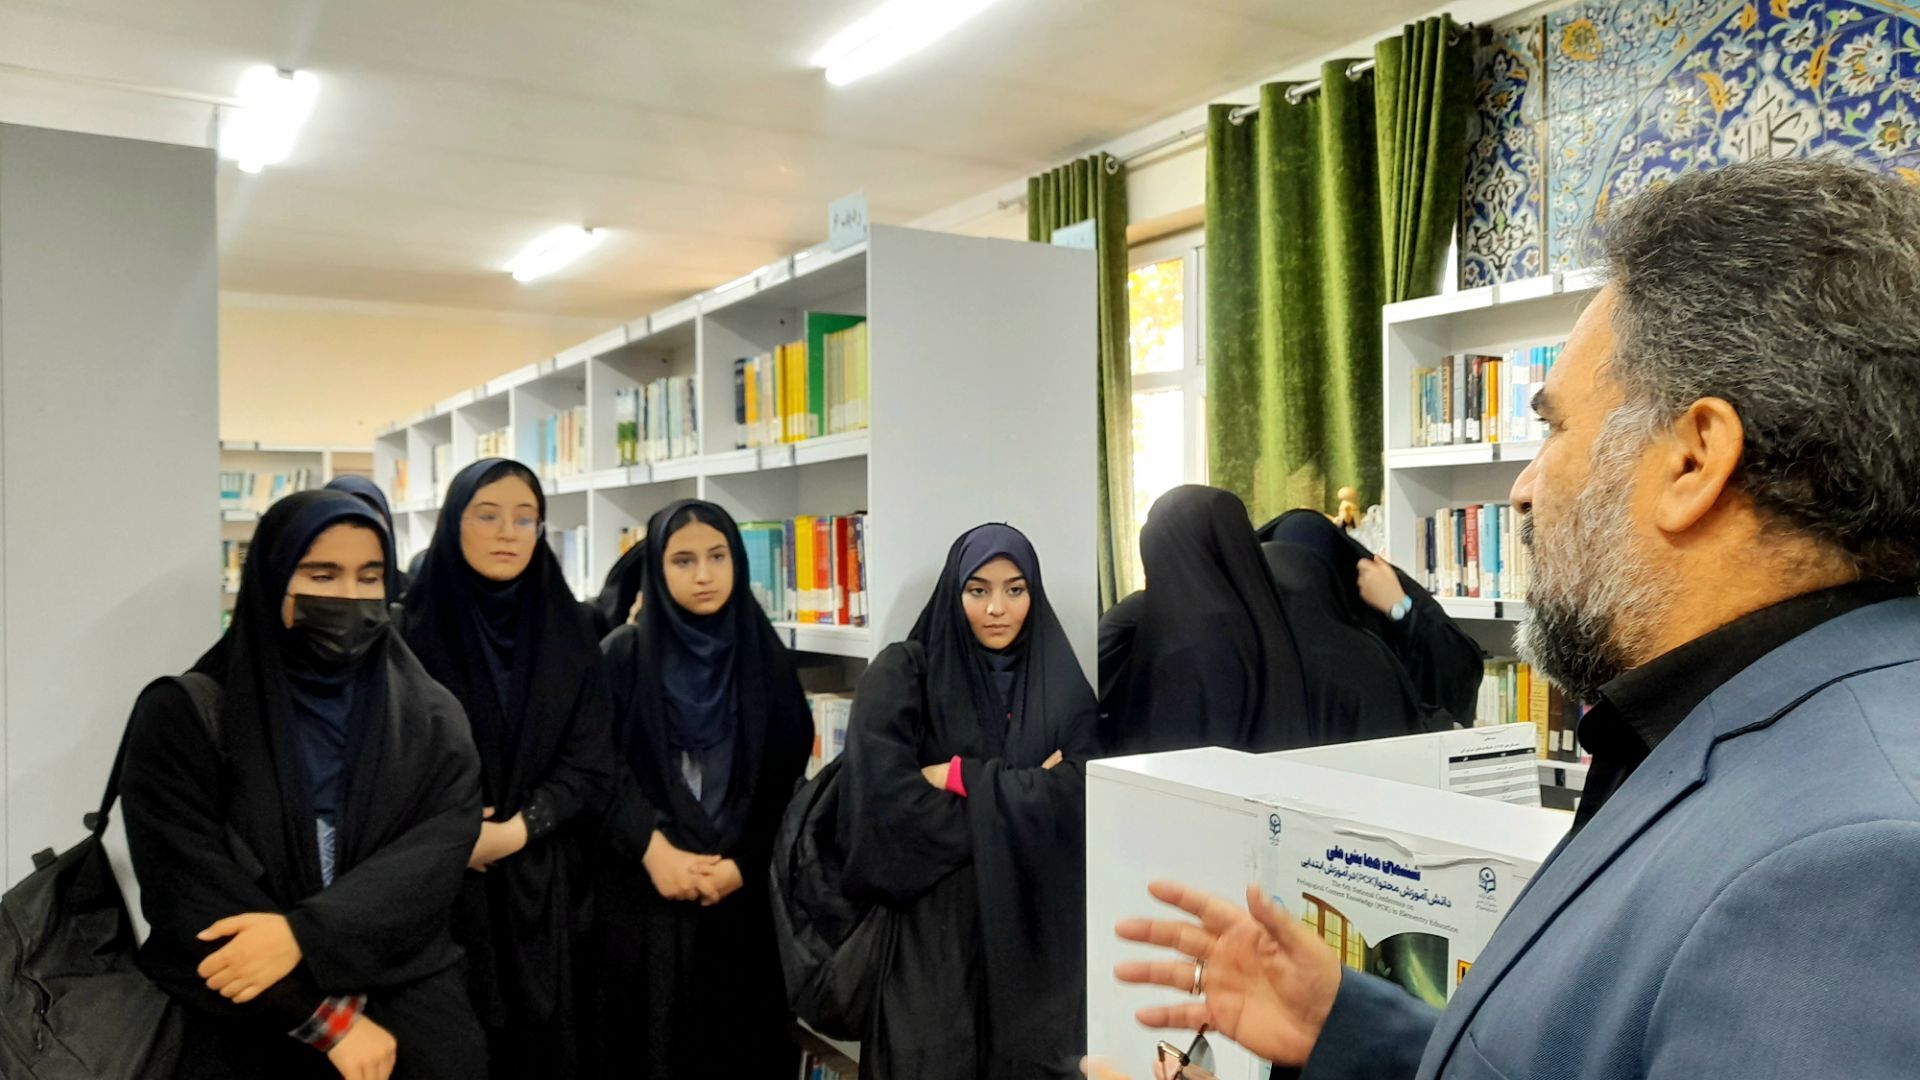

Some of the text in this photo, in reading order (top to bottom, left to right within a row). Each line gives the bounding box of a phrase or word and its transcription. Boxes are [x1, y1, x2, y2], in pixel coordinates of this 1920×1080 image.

[1326, 844, 1344, 862] ملی
[1345, 849, 1381, 871] همایش
[1324, 864, 1348, 879] آموزش
[1399, 885, 1428, 902] آموزش
[1427, 893, 1452, 908] دانش
